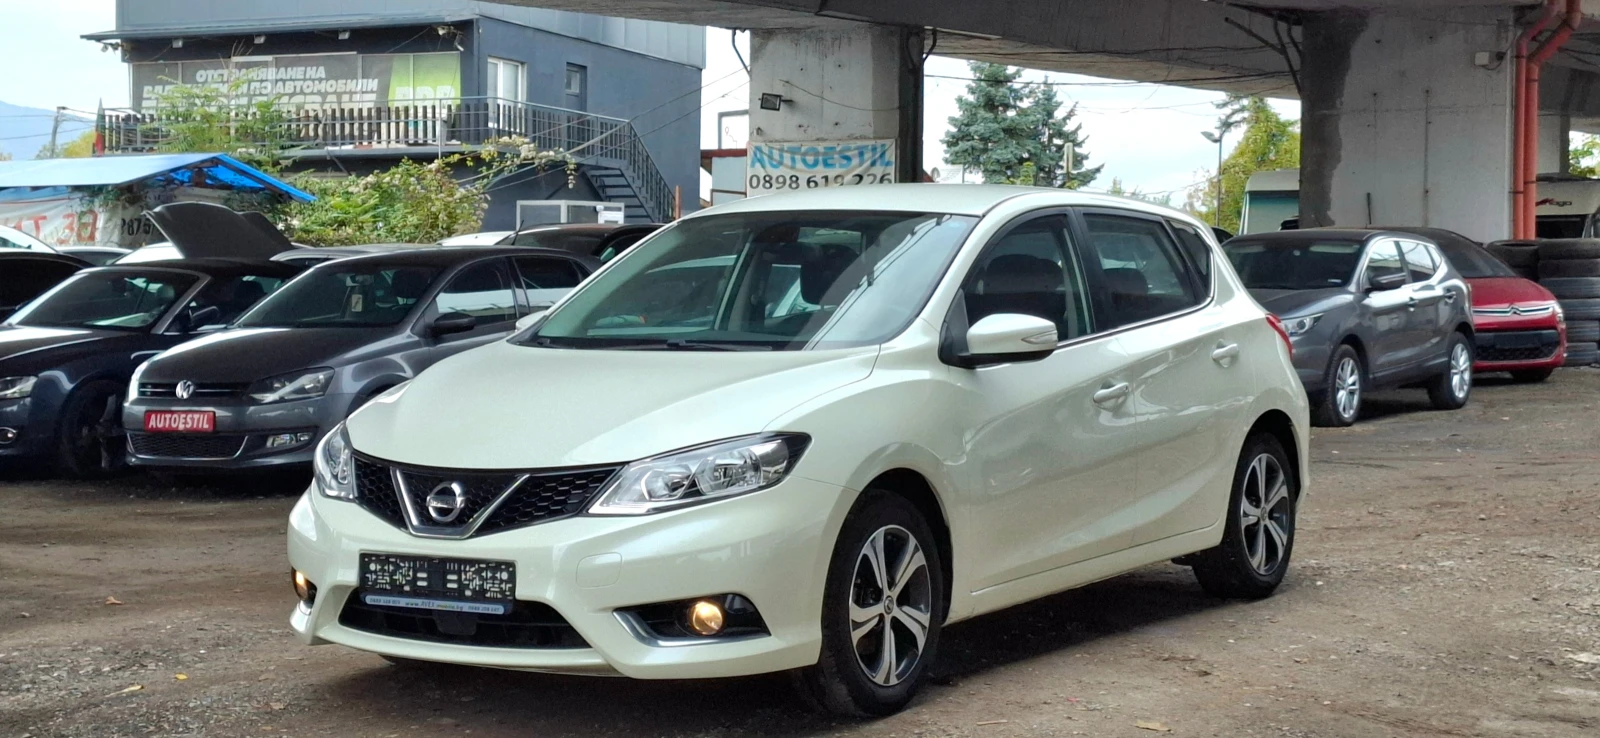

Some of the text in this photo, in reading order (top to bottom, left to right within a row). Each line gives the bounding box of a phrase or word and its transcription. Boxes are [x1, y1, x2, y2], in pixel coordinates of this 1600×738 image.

[272, 78, 379, 93] АВТОМОБИЛИ
[750, 143, 894, 169] AUTOESTIL
[749, 174, 800, 190] 0898
[806, 174, 845, 189] 619
[149, 414, 209, 430] AUTOESTIL
